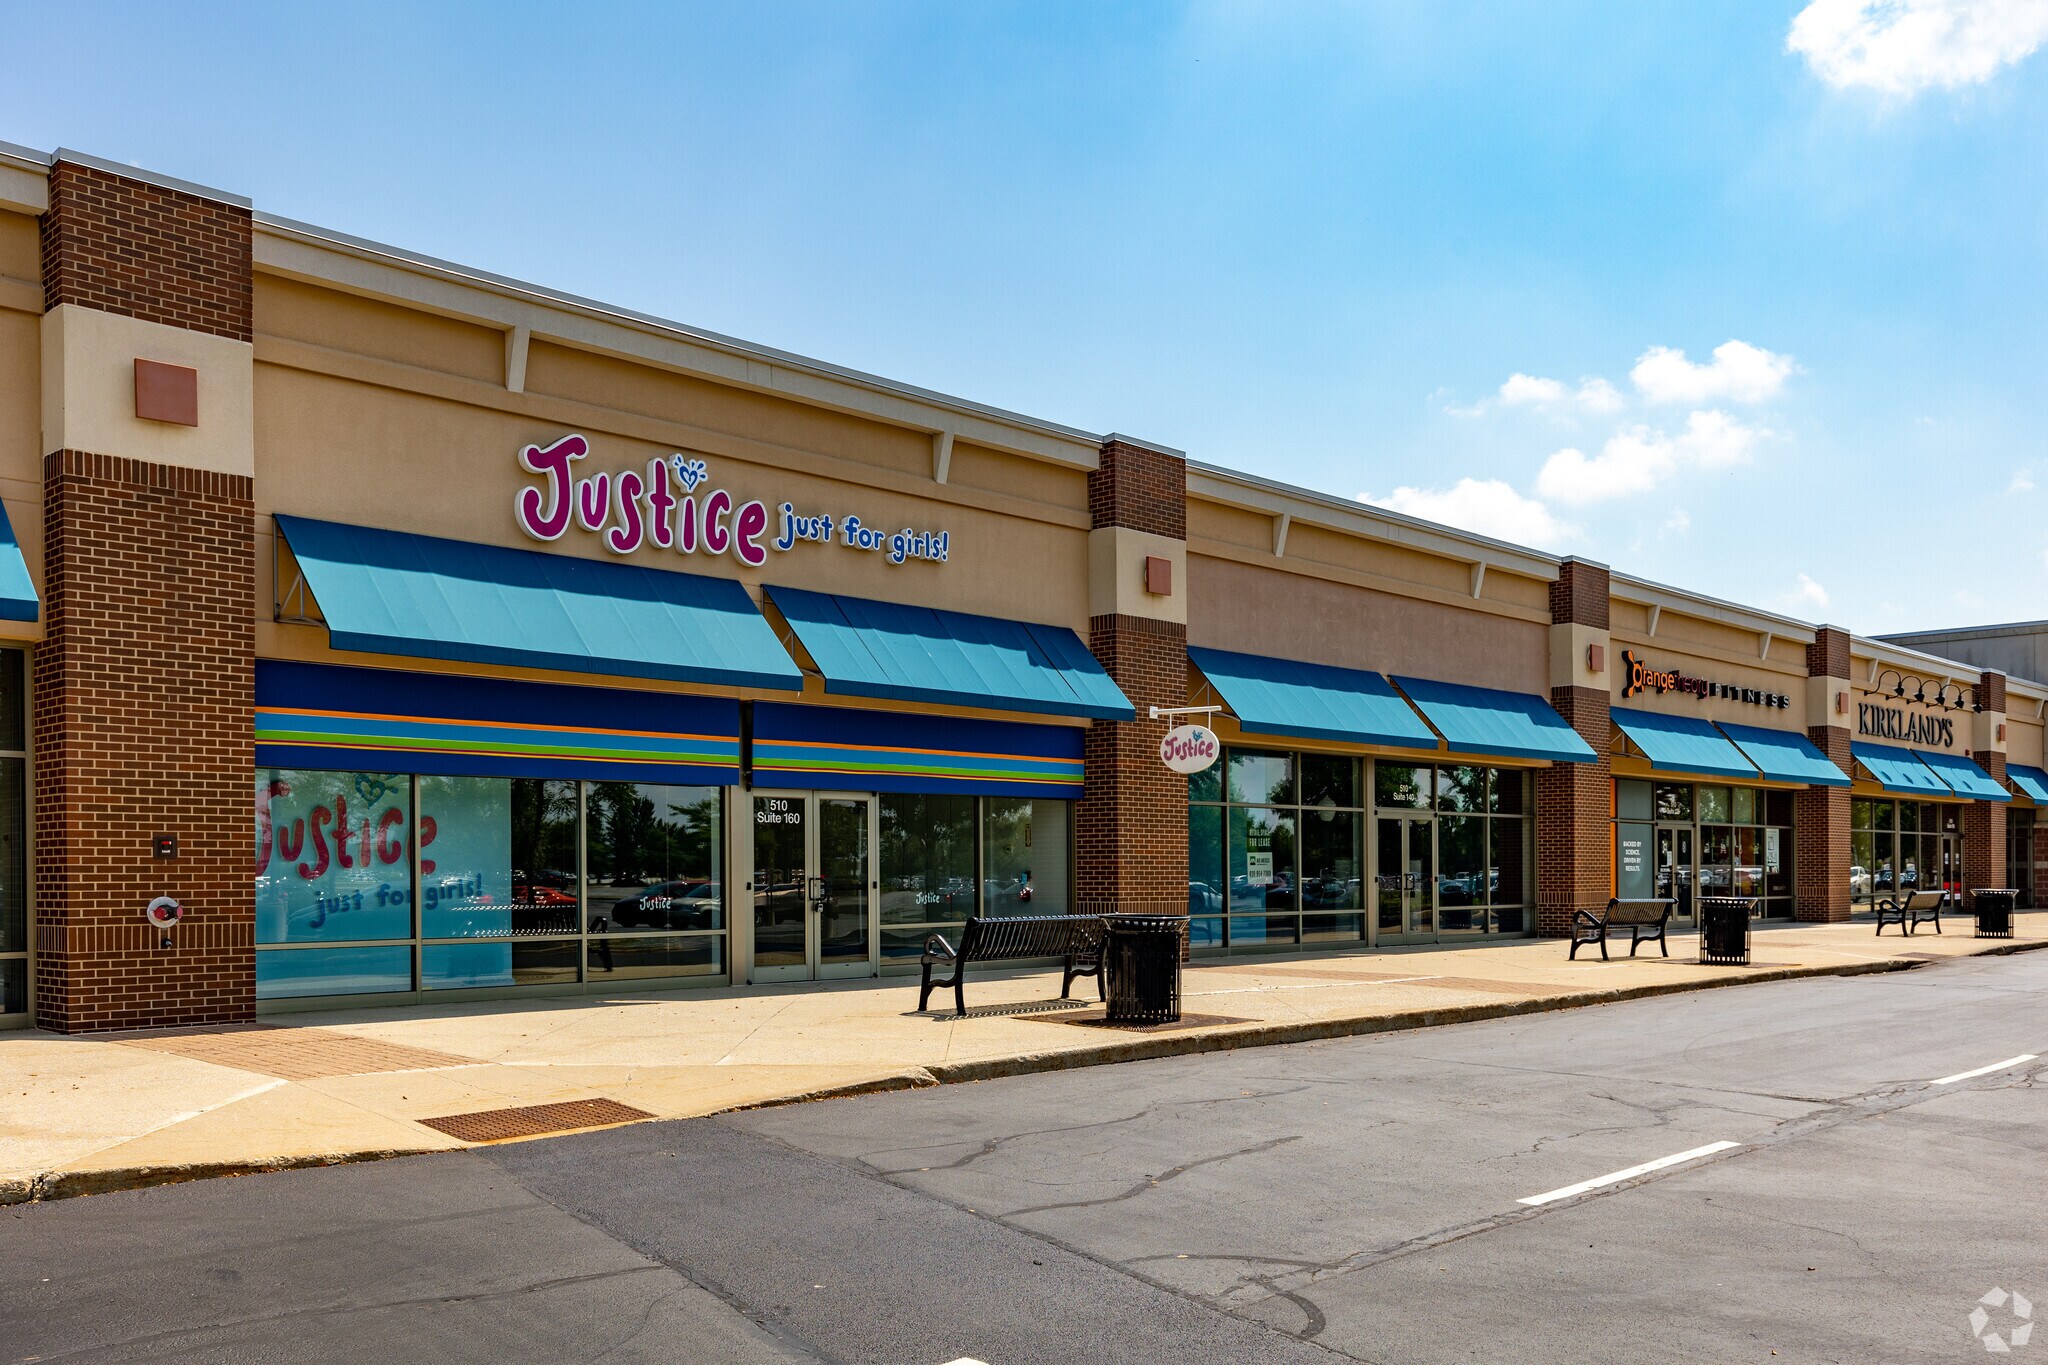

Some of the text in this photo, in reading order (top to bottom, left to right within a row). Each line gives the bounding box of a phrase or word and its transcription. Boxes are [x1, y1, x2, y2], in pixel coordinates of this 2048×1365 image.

[519, 434, 767, 567] Justice
[777, 502, 949, 563] just for girls!
[1711, 683, 1790, 709] FITNESS
[1858, 703, 1954, 748] KIRKLAND'S
[1163, 736, 1214, 761] Justice
[770, 800, 788, 811] 510
[1393, 792, 1405, 801] Suite
[757, 811, 800, 823] Suite 160
[1249, 838, 1270, 847] FOR LEASE
[310, 890, 363, 928] just
[424, 873, 483, 910] girls!
[640, 896, 672, 910] Justice
[916, 891, 940, 905] Justice
